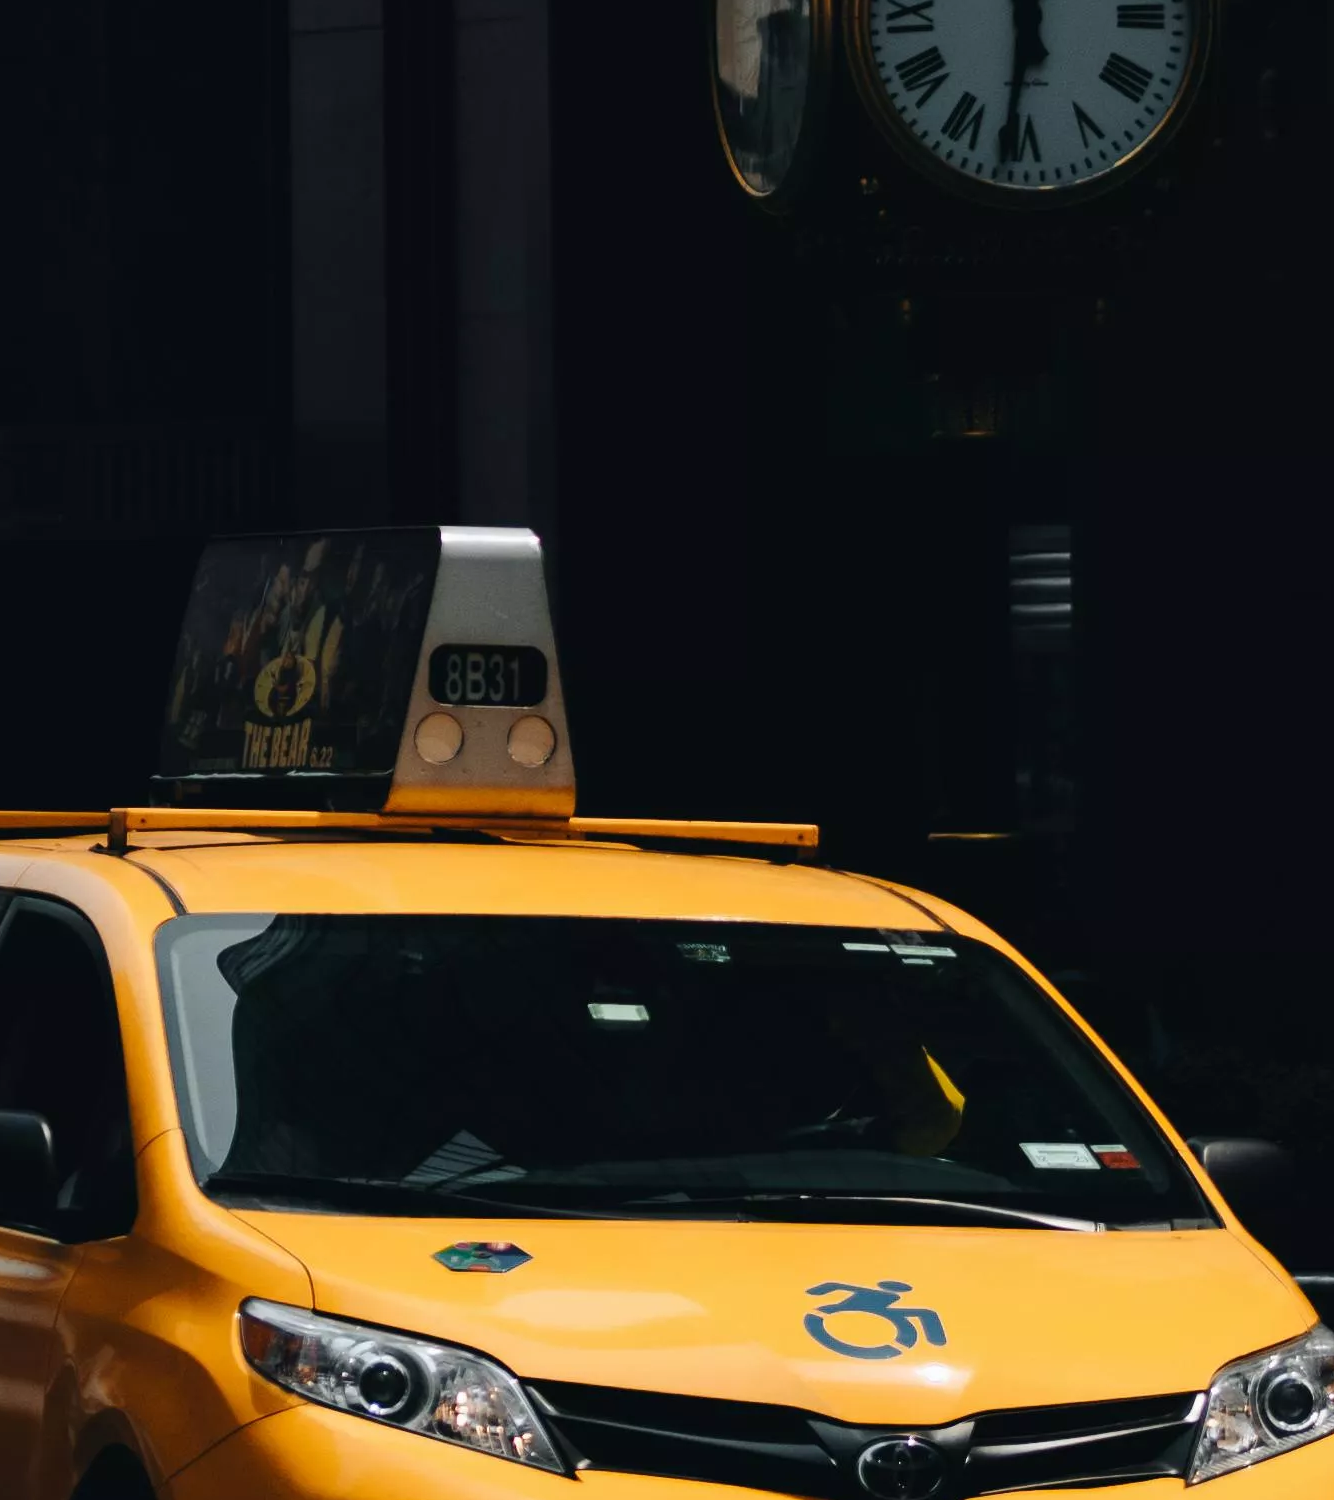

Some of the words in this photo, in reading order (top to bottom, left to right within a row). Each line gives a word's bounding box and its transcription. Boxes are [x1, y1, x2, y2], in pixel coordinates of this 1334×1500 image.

[444, 652, 520, 702] 8B31
[242, 719, 271, 769] THE
[270, 717, 313, 769] BEAR
